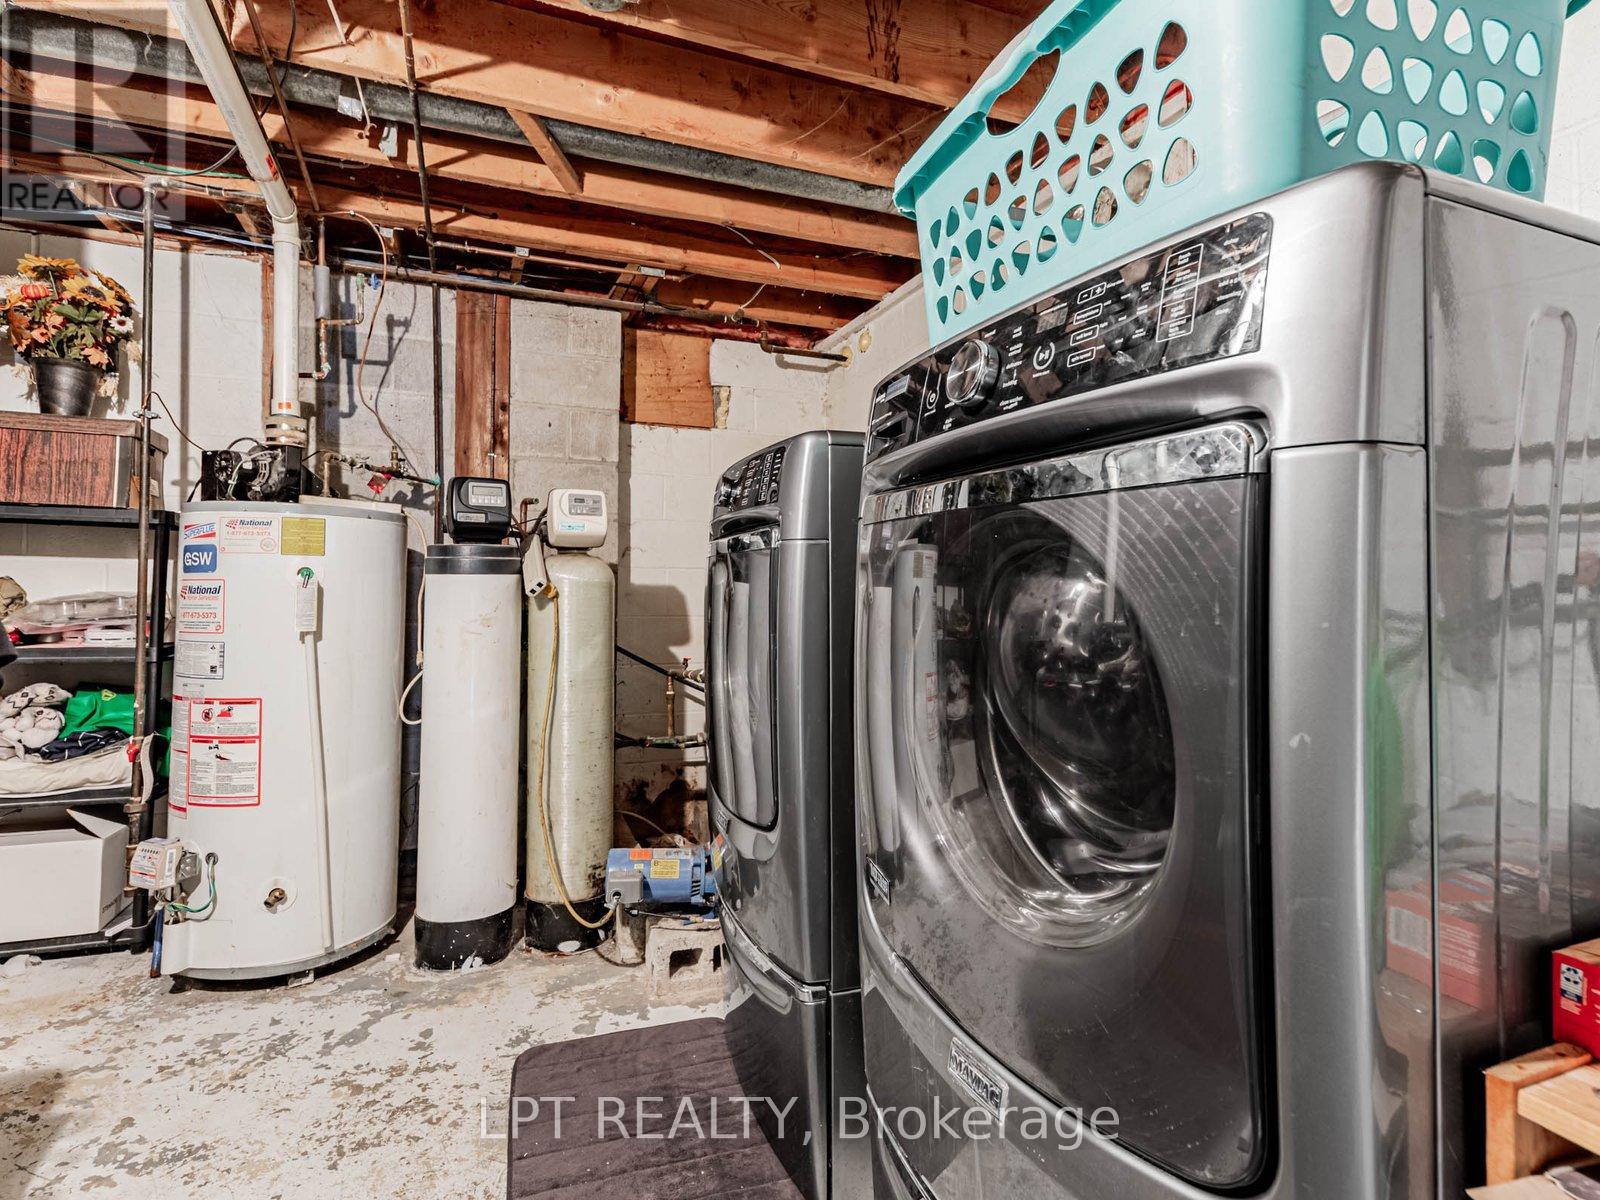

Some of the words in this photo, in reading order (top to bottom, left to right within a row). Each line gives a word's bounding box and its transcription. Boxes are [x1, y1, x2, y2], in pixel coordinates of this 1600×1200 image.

[239, 519, 273, 527] National
[184, 552, 213, 567] GSW
[187, 585, 222, 595] National
[950, 1046, 1000, 1110] MAYTAG
